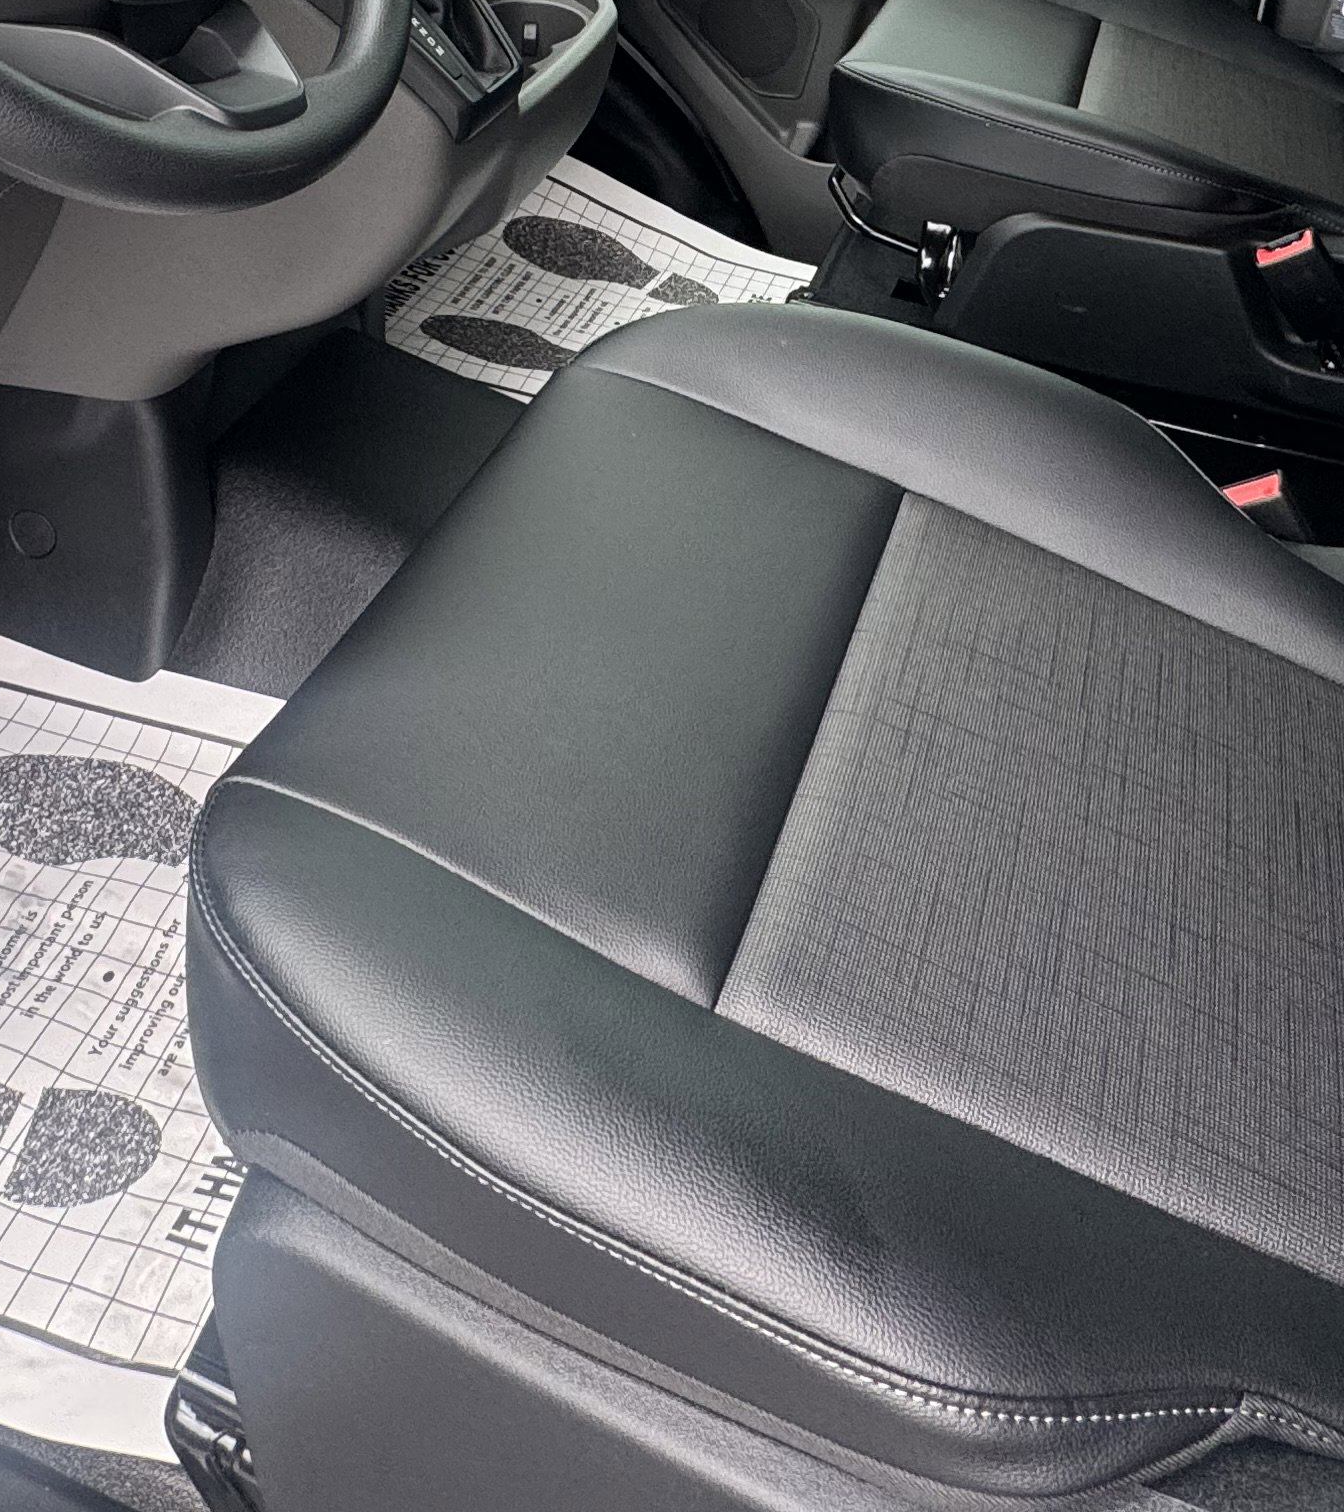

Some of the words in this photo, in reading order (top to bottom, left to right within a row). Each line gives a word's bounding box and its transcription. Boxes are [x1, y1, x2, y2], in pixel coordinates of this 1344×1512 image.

[16, 921, 65, 981] important
[61, 879, 94, 921] person
[21, 910, 38, 922] is
[20, 1006, 40, 1019] in
[34, 985, 57, 1003] the
[54, 947, 84, 983] world
[78, 933, 94, 946] to
[88, 1024, 118, 1057] Your
[115, 940, 169, 1023] suggestions
[163, 918, 181, 939] for
[169, 973, 186, 997] our
[158, 1053, 177, 1076] are
[165, 1208, 219, 1252] IT
